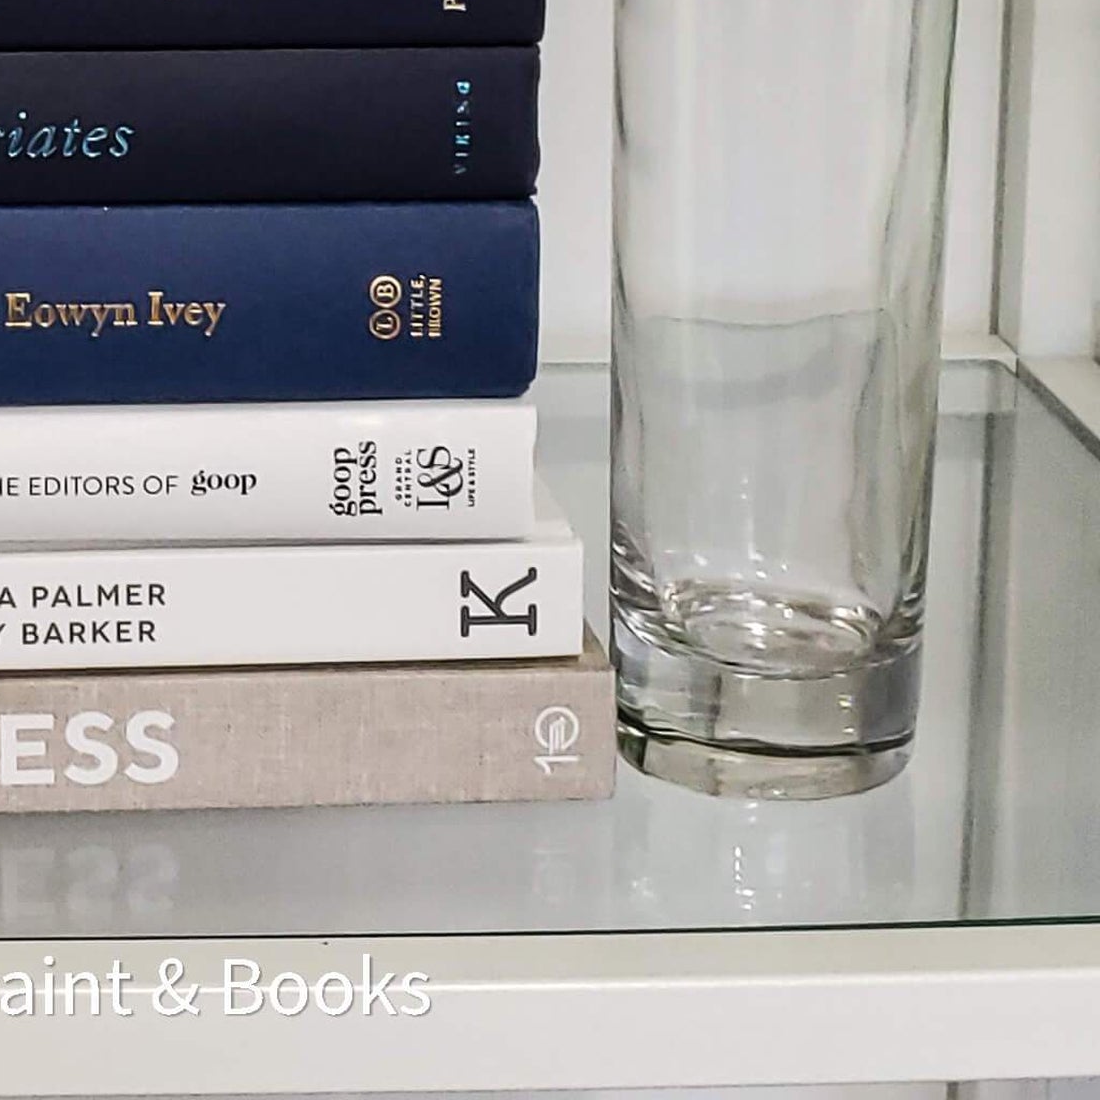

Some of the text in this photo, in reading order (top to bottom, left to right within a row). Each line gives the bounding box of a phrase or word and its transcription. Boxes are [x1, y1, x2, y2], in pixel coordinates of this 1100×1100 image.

[4, 291, 227, 337] Eowyn Ivey
[410, 274, 426, 338] LITTLE,
[28, 475, 136, 497] EDITORS
[142, 475, 179, 495] OF
[190, 470, 257, 496] goop
[328, 447, 358, 517] goop
[359, 440, 383, 515] press
[404, 450, 413, 507] CENTRAL
[468, 449, 476, 477] STYLE
[468, 488, 476, 508] LIFE
[32, 583, 165, 608] PALMER
[460, 566, 538, 638] K
[22, 620, 156, 645] BARKER
